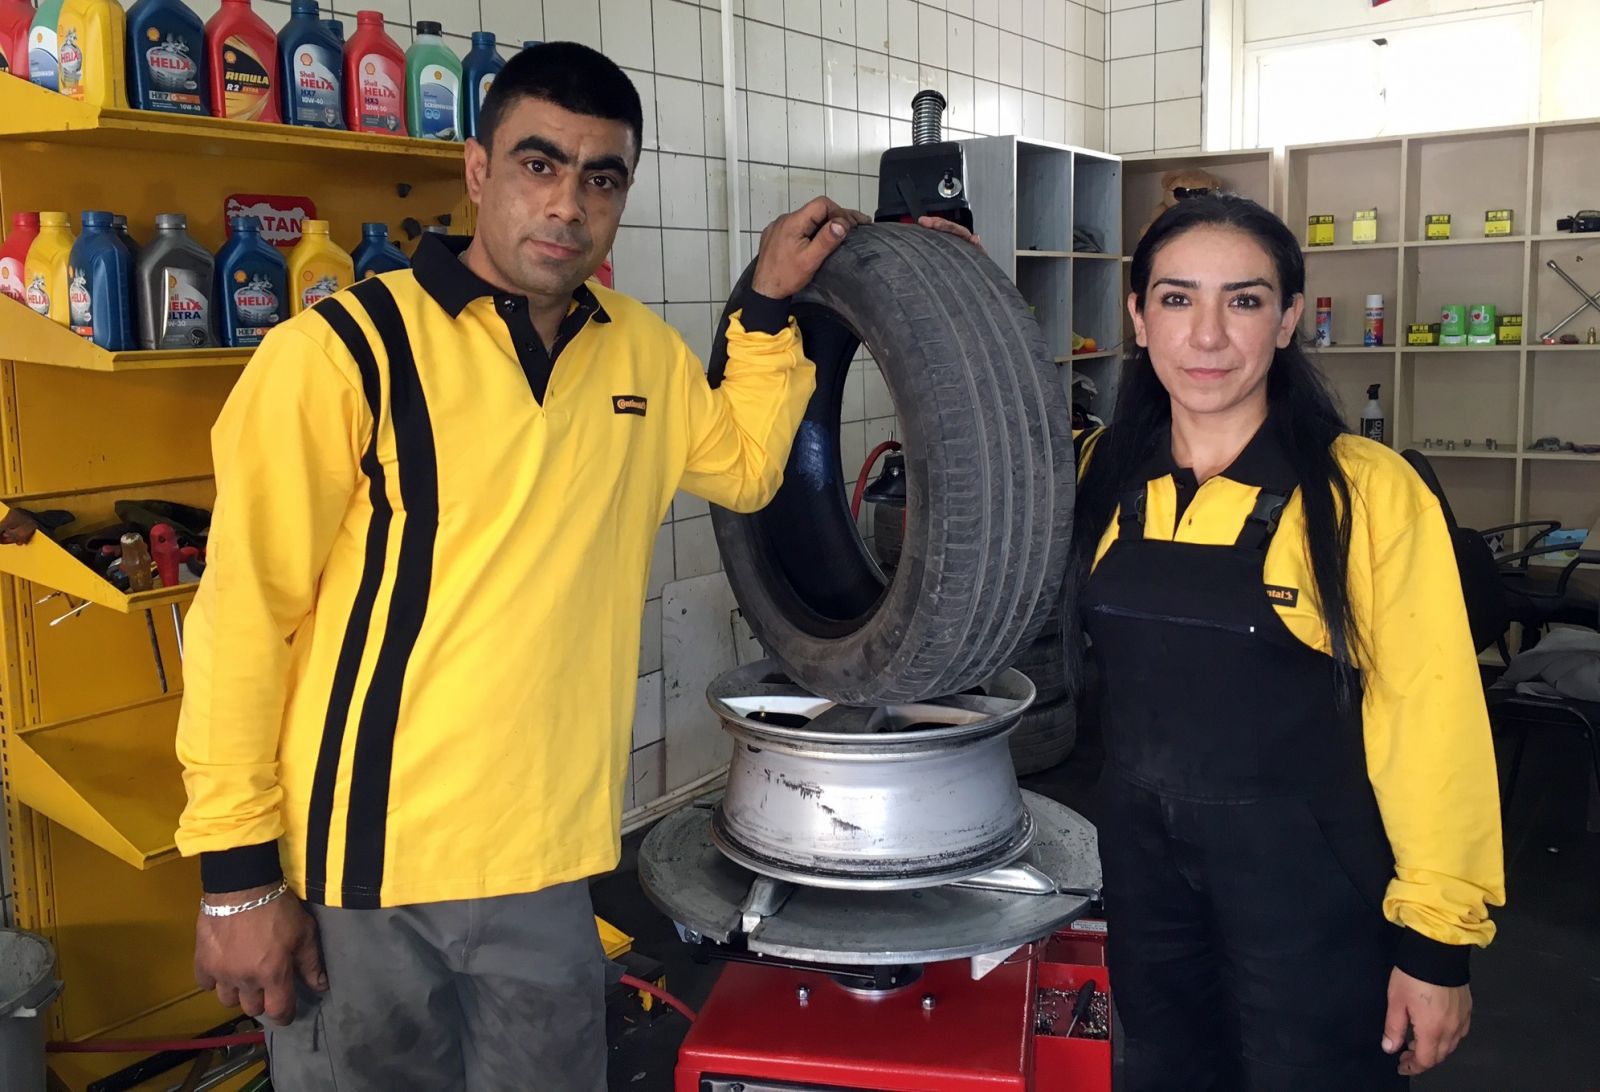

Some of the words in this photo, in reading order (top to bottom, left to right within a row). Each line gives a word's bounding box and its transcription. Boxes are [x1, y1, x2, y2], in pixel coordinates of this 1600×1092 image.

[150, 56, 191, 70] HELIX
[225, 71, 269, 85] RIMULA
[300, 77, 334, 91] HELIX
[364, 86, 396, 98] HELIX
[237, 296, 274, 306] HELIX
